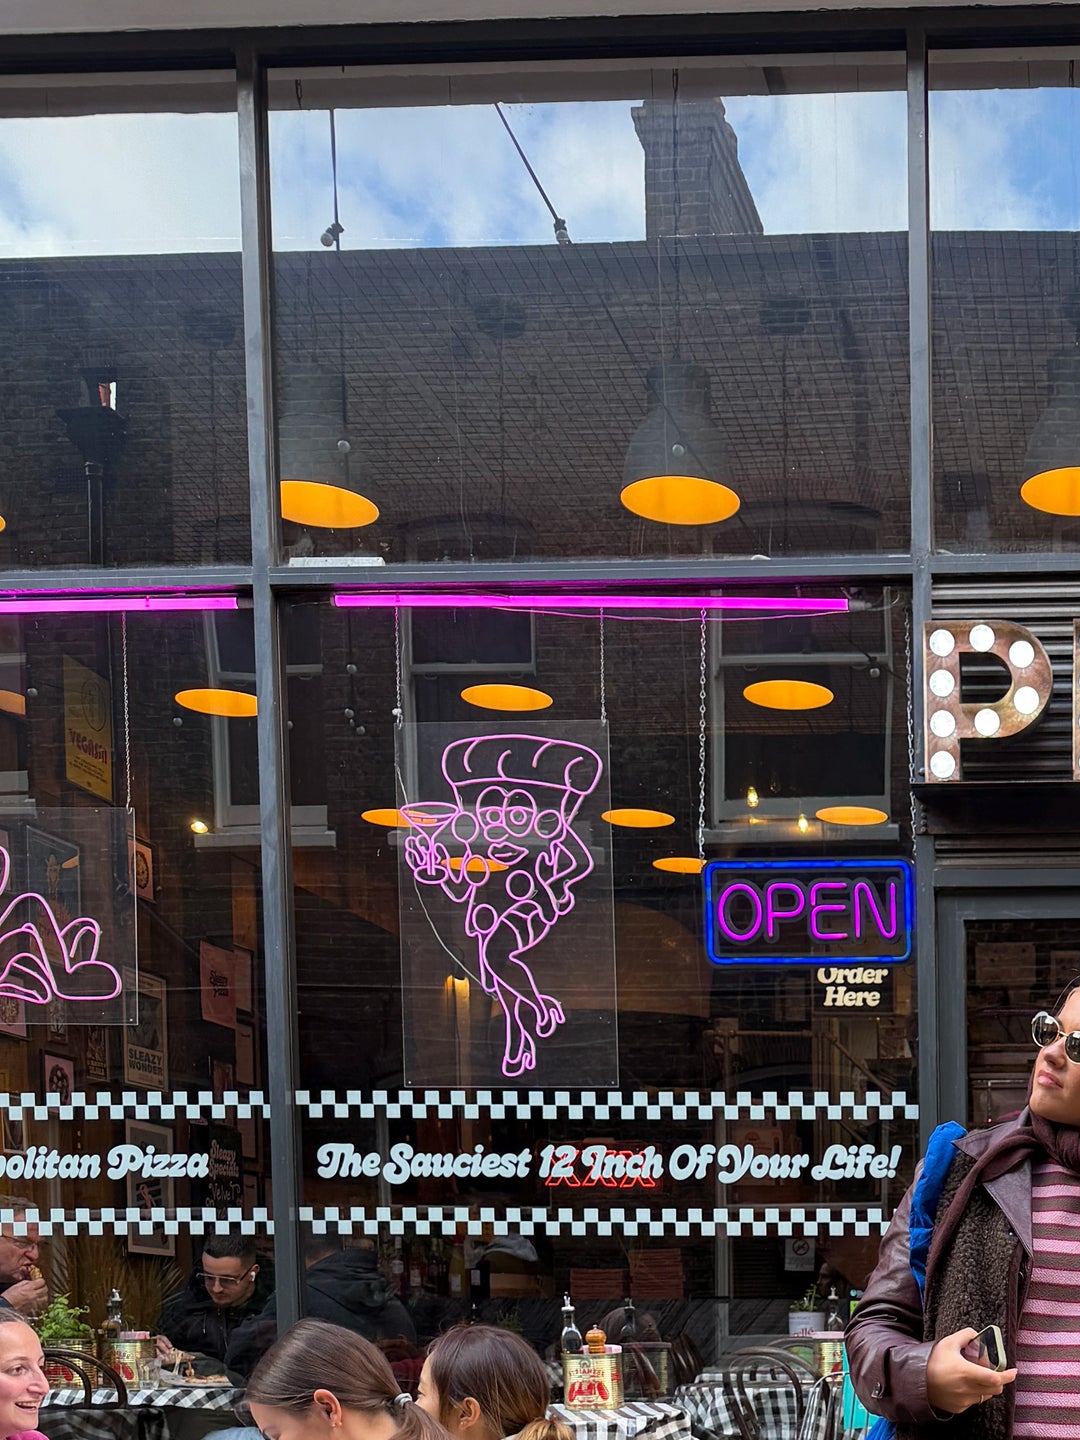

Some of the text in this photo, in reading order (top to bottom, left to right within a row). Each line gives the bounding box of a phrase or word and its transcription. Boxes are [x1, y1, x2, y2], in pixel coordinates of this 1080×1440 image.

[718, 882, 897, 941] OPEN
[817, 967, 888, 984] Order
[823, 986, 881, 1007] Here
[128, 1048, 163, 1066] SLEAZY
[128, 1060, 164, 1077] WONDER
[0, 1144, 209, 1180] olitan Pizza
[317, 1143, 902, 1184] The Sauciest 12 Inch Of Your Life!
